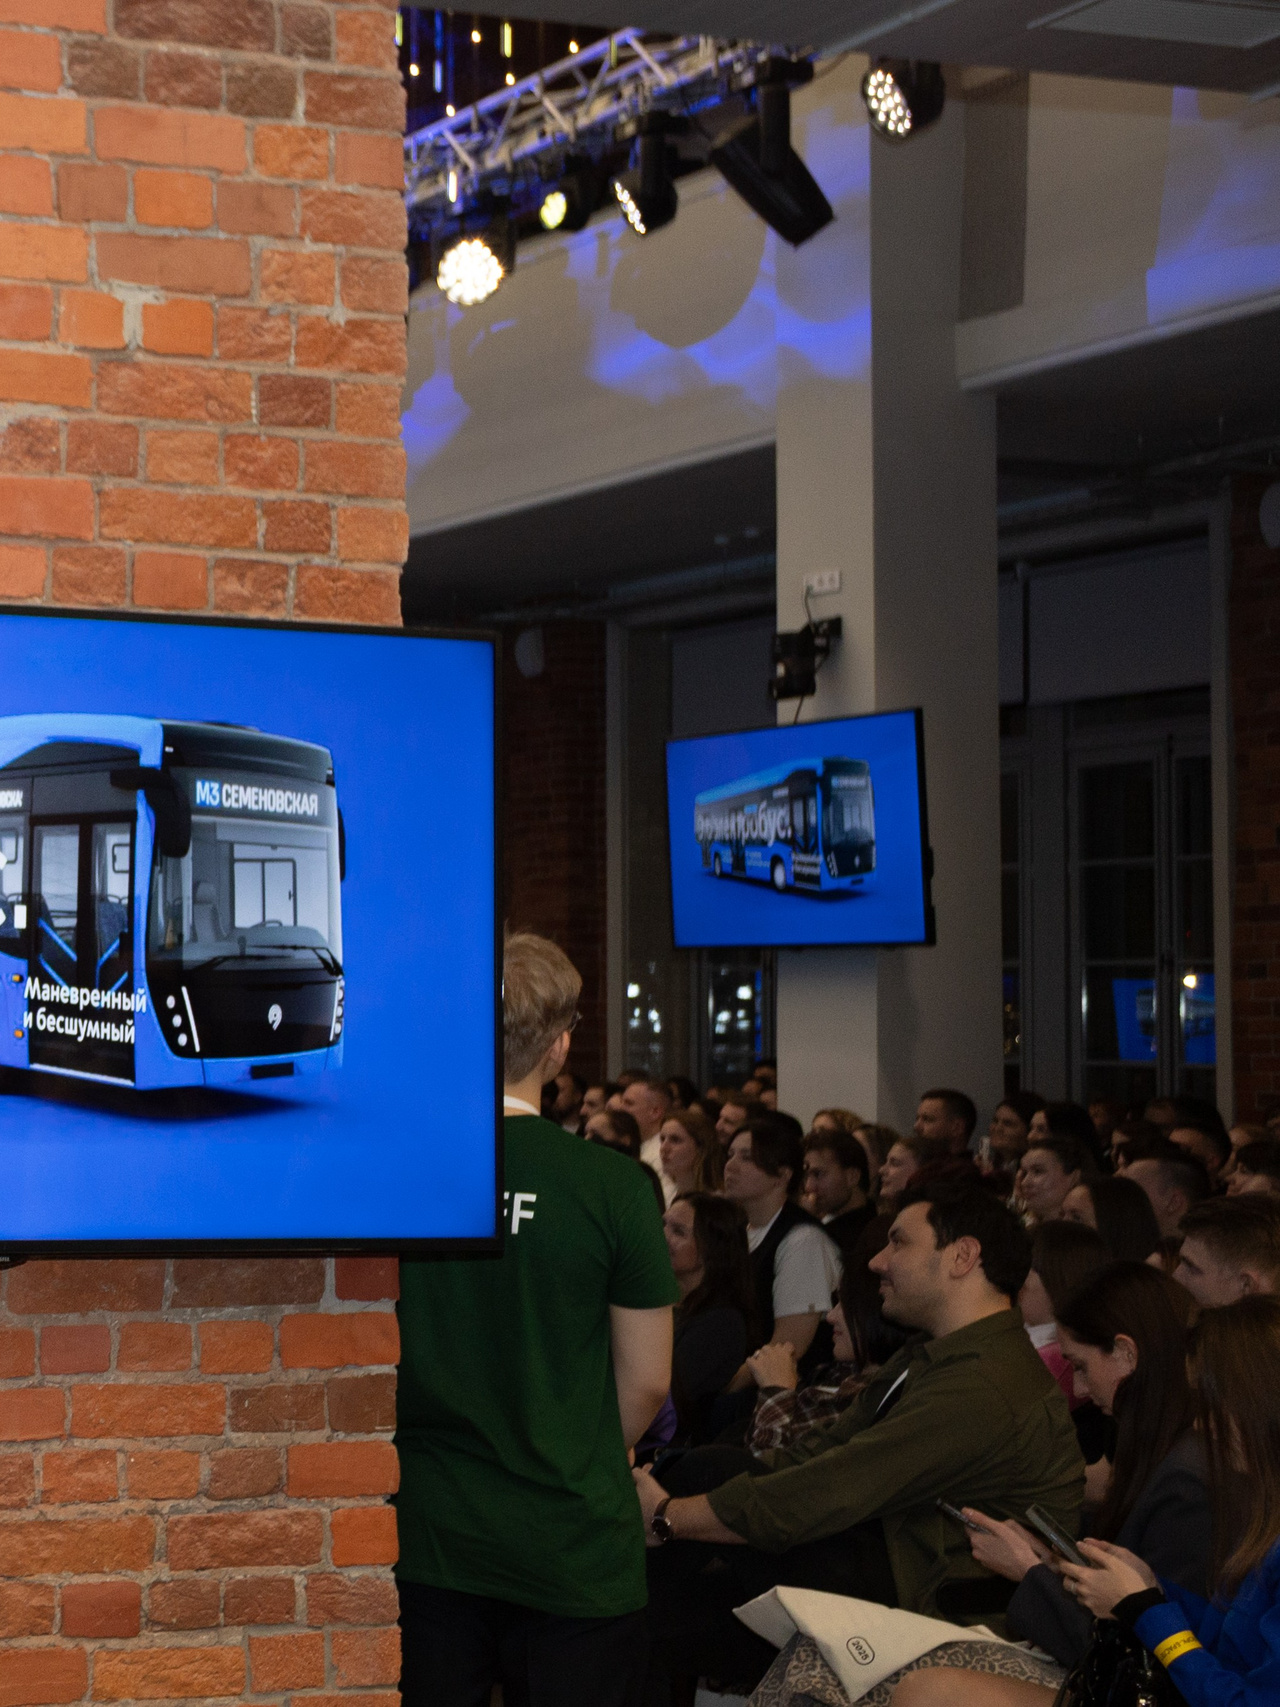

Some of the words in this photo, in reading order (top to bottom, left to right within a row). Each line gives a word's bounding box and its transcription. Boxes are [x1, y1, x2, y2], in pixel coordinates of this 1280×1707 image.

[221, 783, 319, 817] СЕМЕНОВСКАЯ
[23, 976, 147, 1013] Маневренный
[23, 1010, 33, 1029] и
[36, 1006, 136, 1044] бесшумный
[504, 1191, 537, 1235] F
[851, 1640, 870, 1661] 2025
